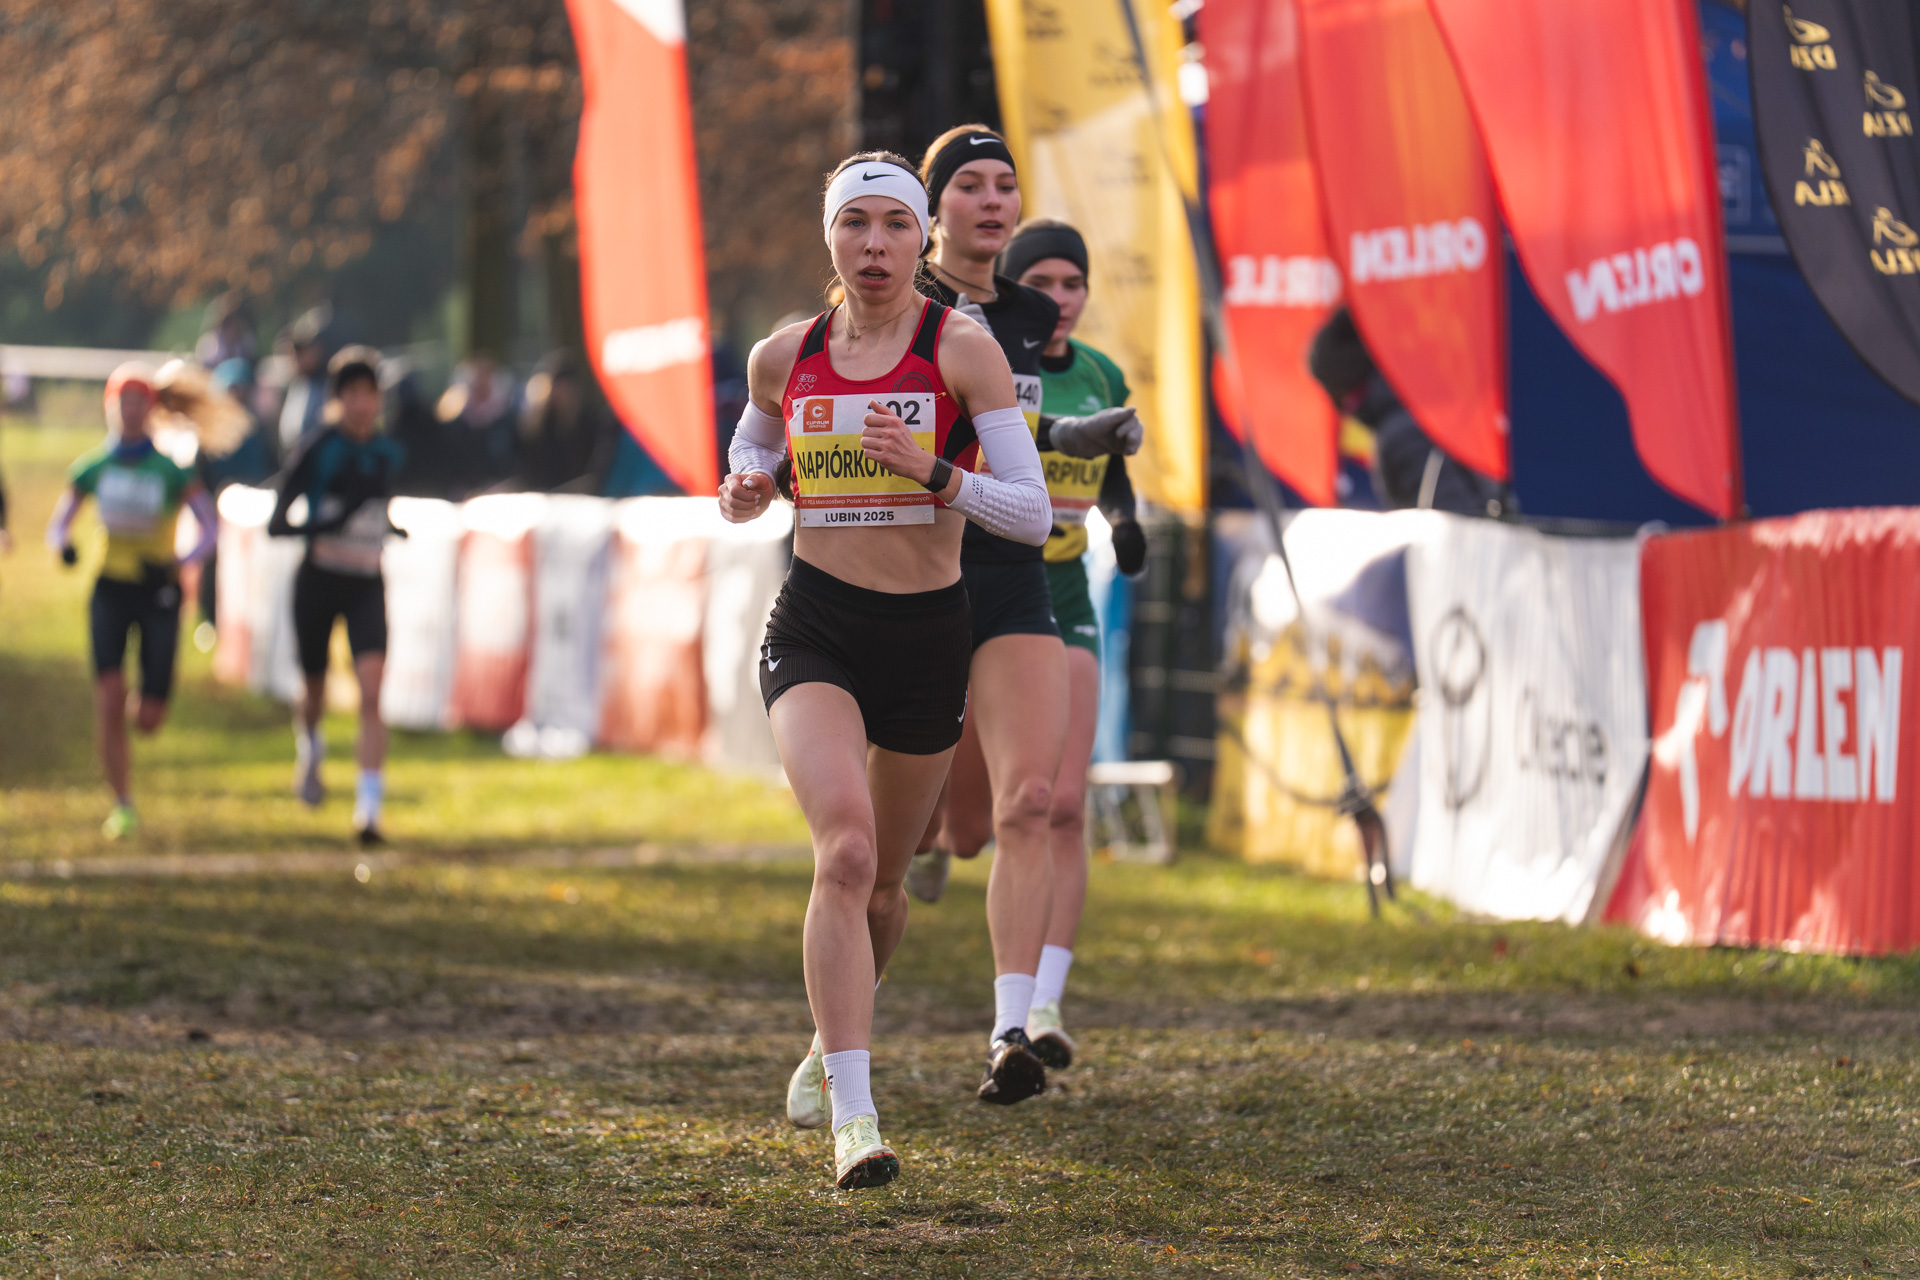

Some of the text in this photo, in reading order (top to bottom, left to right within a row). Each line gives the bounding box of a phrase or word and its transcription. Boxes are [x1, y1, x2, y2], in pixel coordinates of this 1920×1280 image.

[867, 400, 921, 425] 02
[796, 444, 892, 479] NAPIÓRKO
[869, 497, 892, 505] Biegach
[825, 511, 895, 523] LUBIN 2025
[1728, 646, 1903, 804] ORLEN
